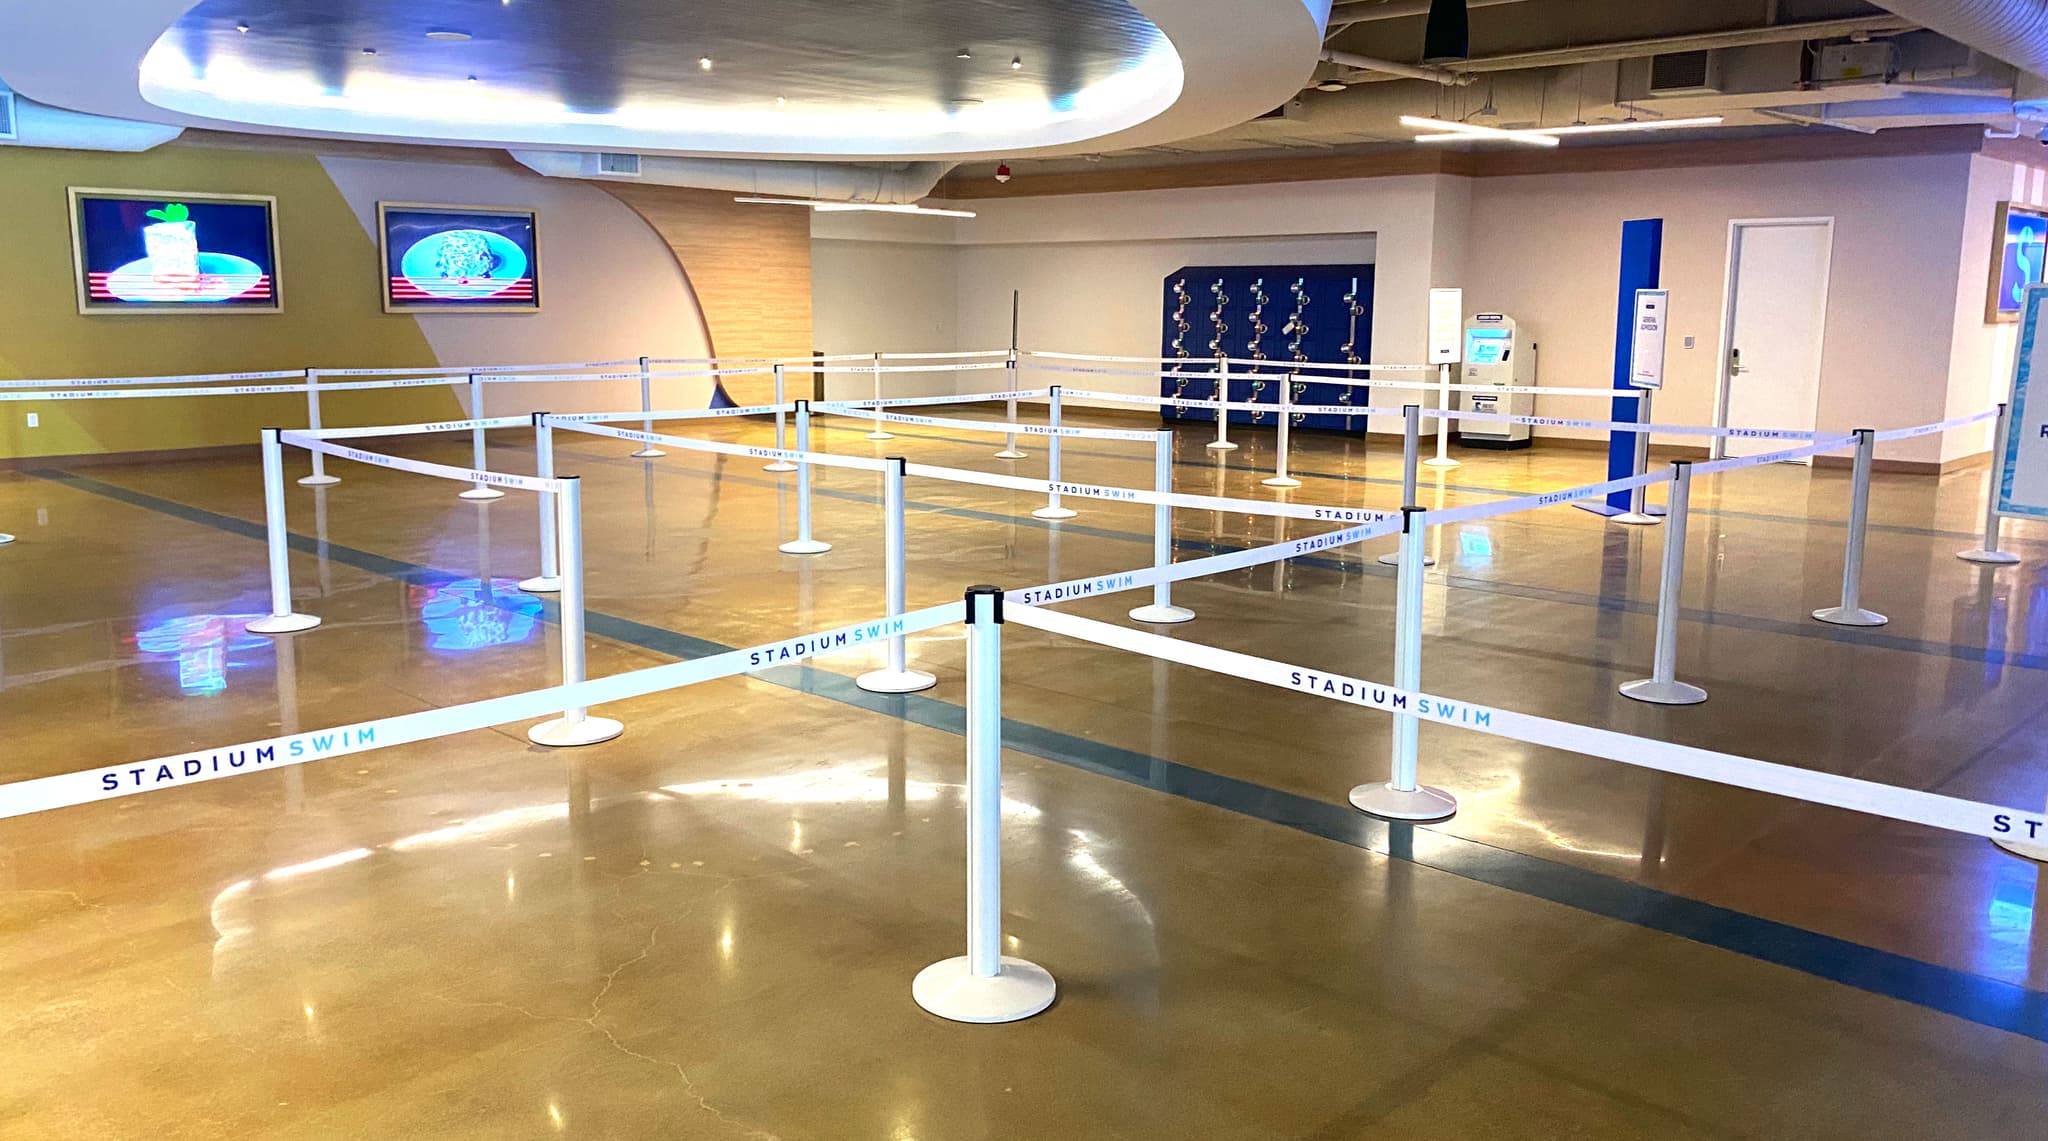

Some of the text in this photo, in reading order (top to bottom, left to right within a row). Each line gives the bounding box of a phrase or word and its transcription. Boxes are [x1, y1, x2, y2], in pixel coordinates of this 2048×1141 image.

[716, 408, 750, 416] STADIUM
[886, 414, 914, 422] STADIUM
[1521, 417, 1564, 425] STADIUM
[425, 422, 471, 431] STADIUM
[1024, 426, 1058, 434] STADIUM
[617, 430, 644, 439] STADIUM
[1729, 429, 1779, 438] STADIUM
[348, 451, 373, 461] STADIUM
[749, 448, 782, 457] STADIUM
[470, 472, 503, 482] STADIUM
[1048, 484, 1135, 499] STADIUM SWIM
[1539, 493, 1573, 505] STADIUM
[1315, 509, 1383, 522] STADIUM
[1296, 527, 1371, 552] STADIUM SWIM
[1024, 576, 1133, 604] STADIUM SWIM
[750, 620, 903, 665] STADIUM SWIM
[1291, 672, 1490, 727] STADIUM SWIM
[102, 727, 375, 791] STADIUM SWIM
